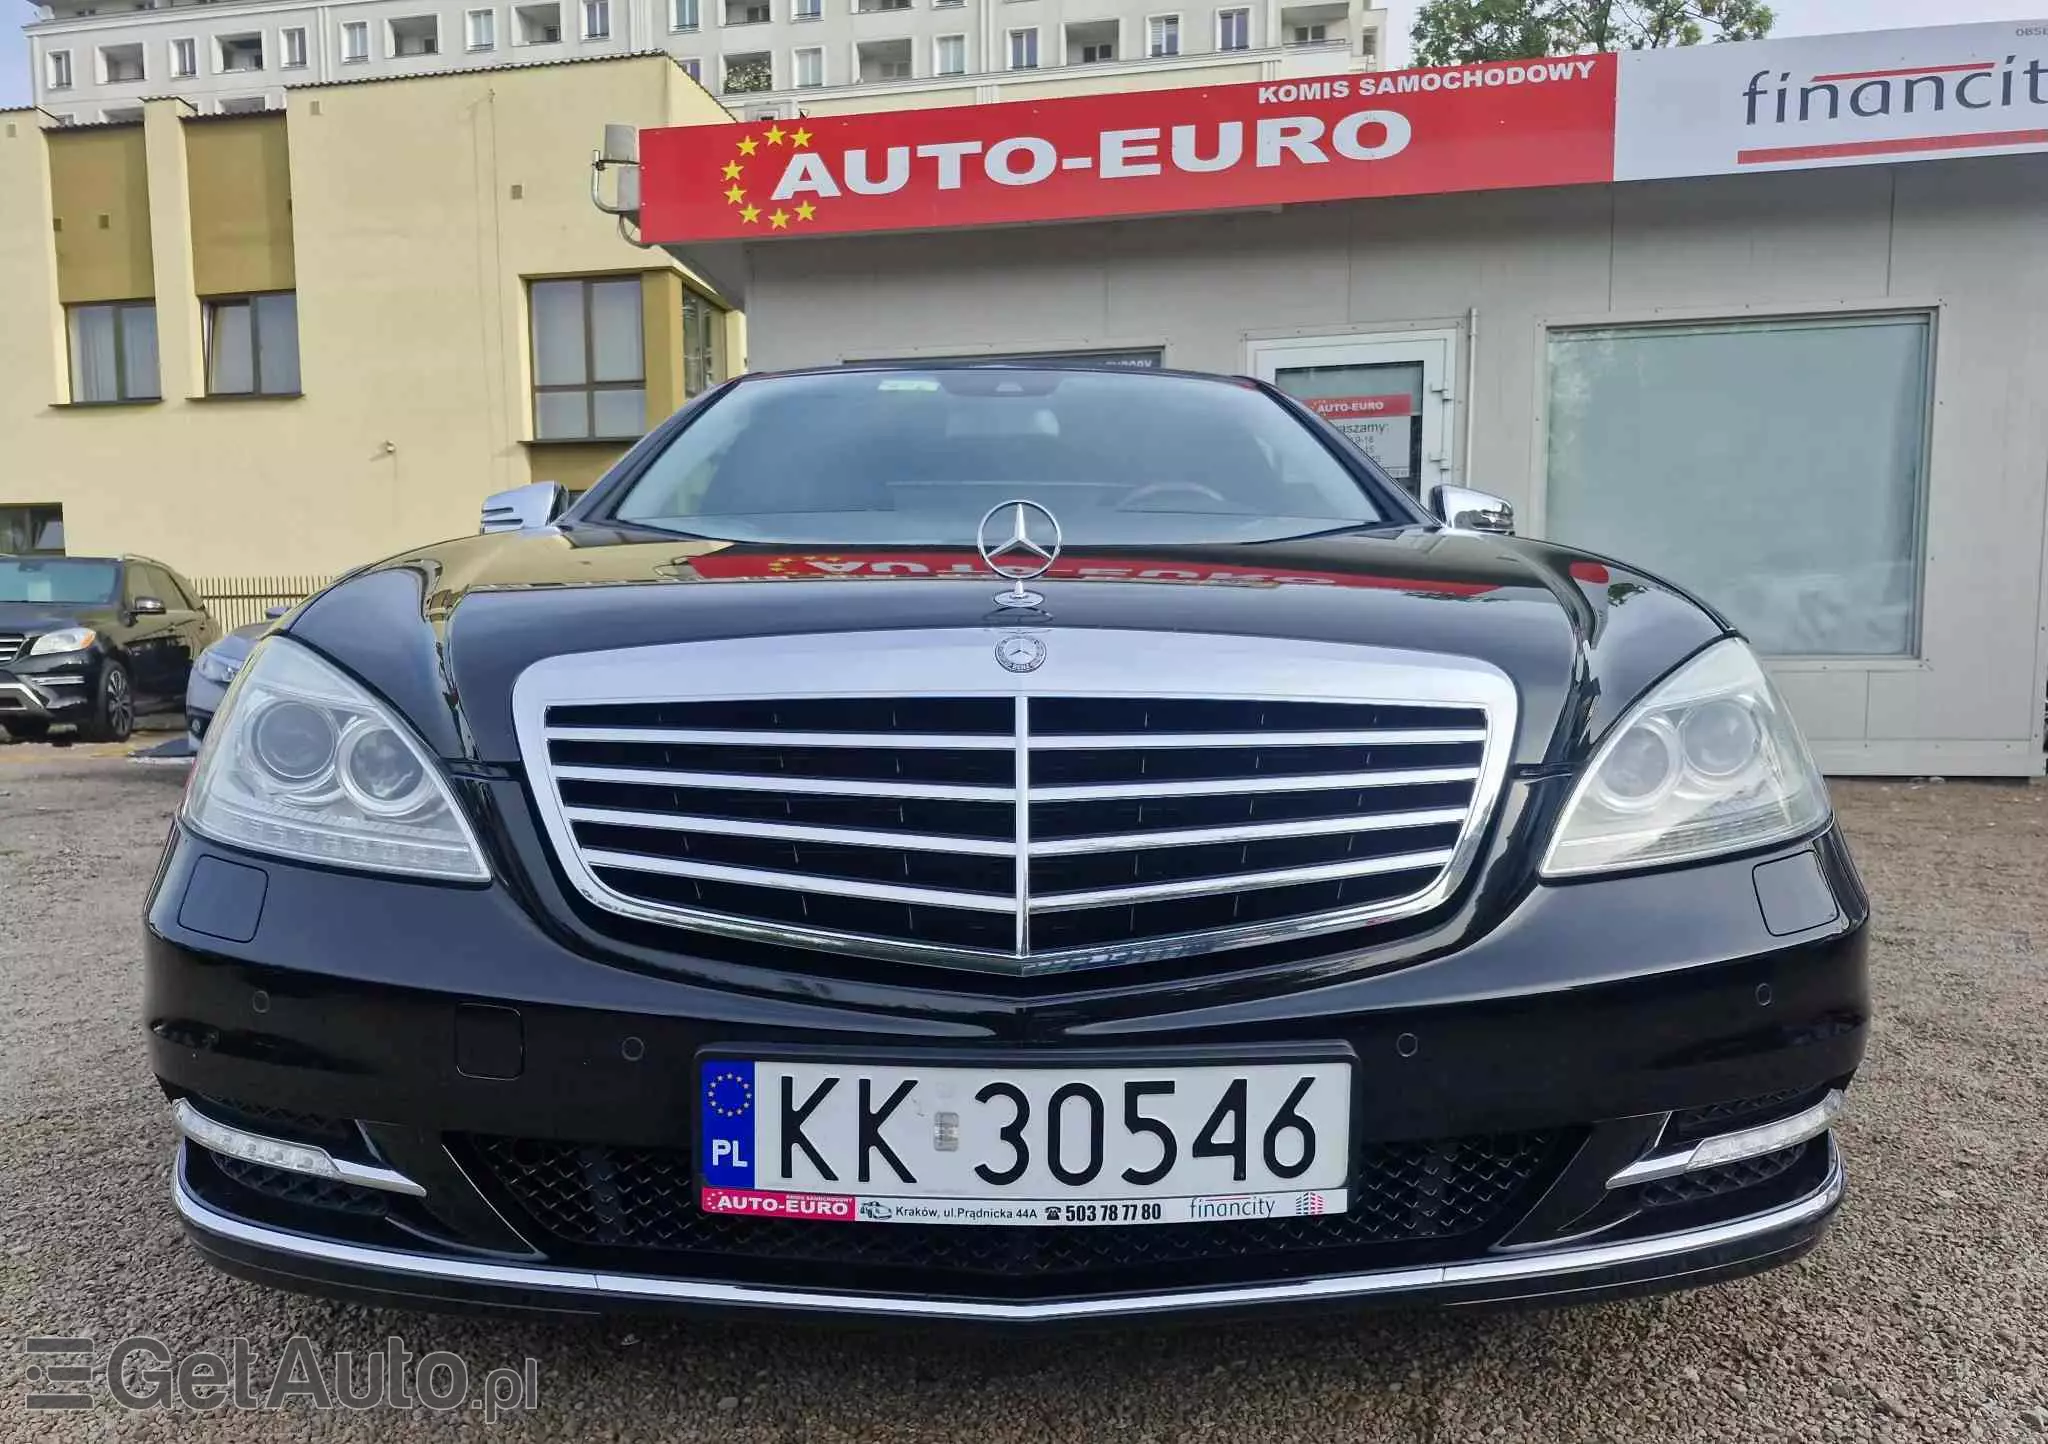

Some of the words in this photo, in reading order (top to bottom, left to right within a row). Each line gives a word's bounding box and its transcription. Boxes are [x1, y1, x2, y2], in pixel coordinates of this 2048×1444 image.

[1258, 81, 1350, 105] KOMIS
[1359, 60, 1596, 96] SAMOCHODOWY
[770, 110, 1413, 201] AUTO-EURO
[1317, 401, 1384, 413] AUTO-EURO
[779, 1075, 919, 1184] KK
[973, 1076, 1317, 1187] 30546
[713, 1139, 748, 1168] PL
[717, 1195, 849, 1216] AUTO-EURO
[896, 1205, 941, 1219] Kraków,
[1016, 1208, 1037, 1218] 44A
[1065, 1205, 1097, 1222] 503
[1101, 1205, 1119, 1221] 78
[1122, 1205, 1140, 1221] 77
[1141, 1203, 1162, 1220] 80
[1190, 1196, 1275, 1217] financity
